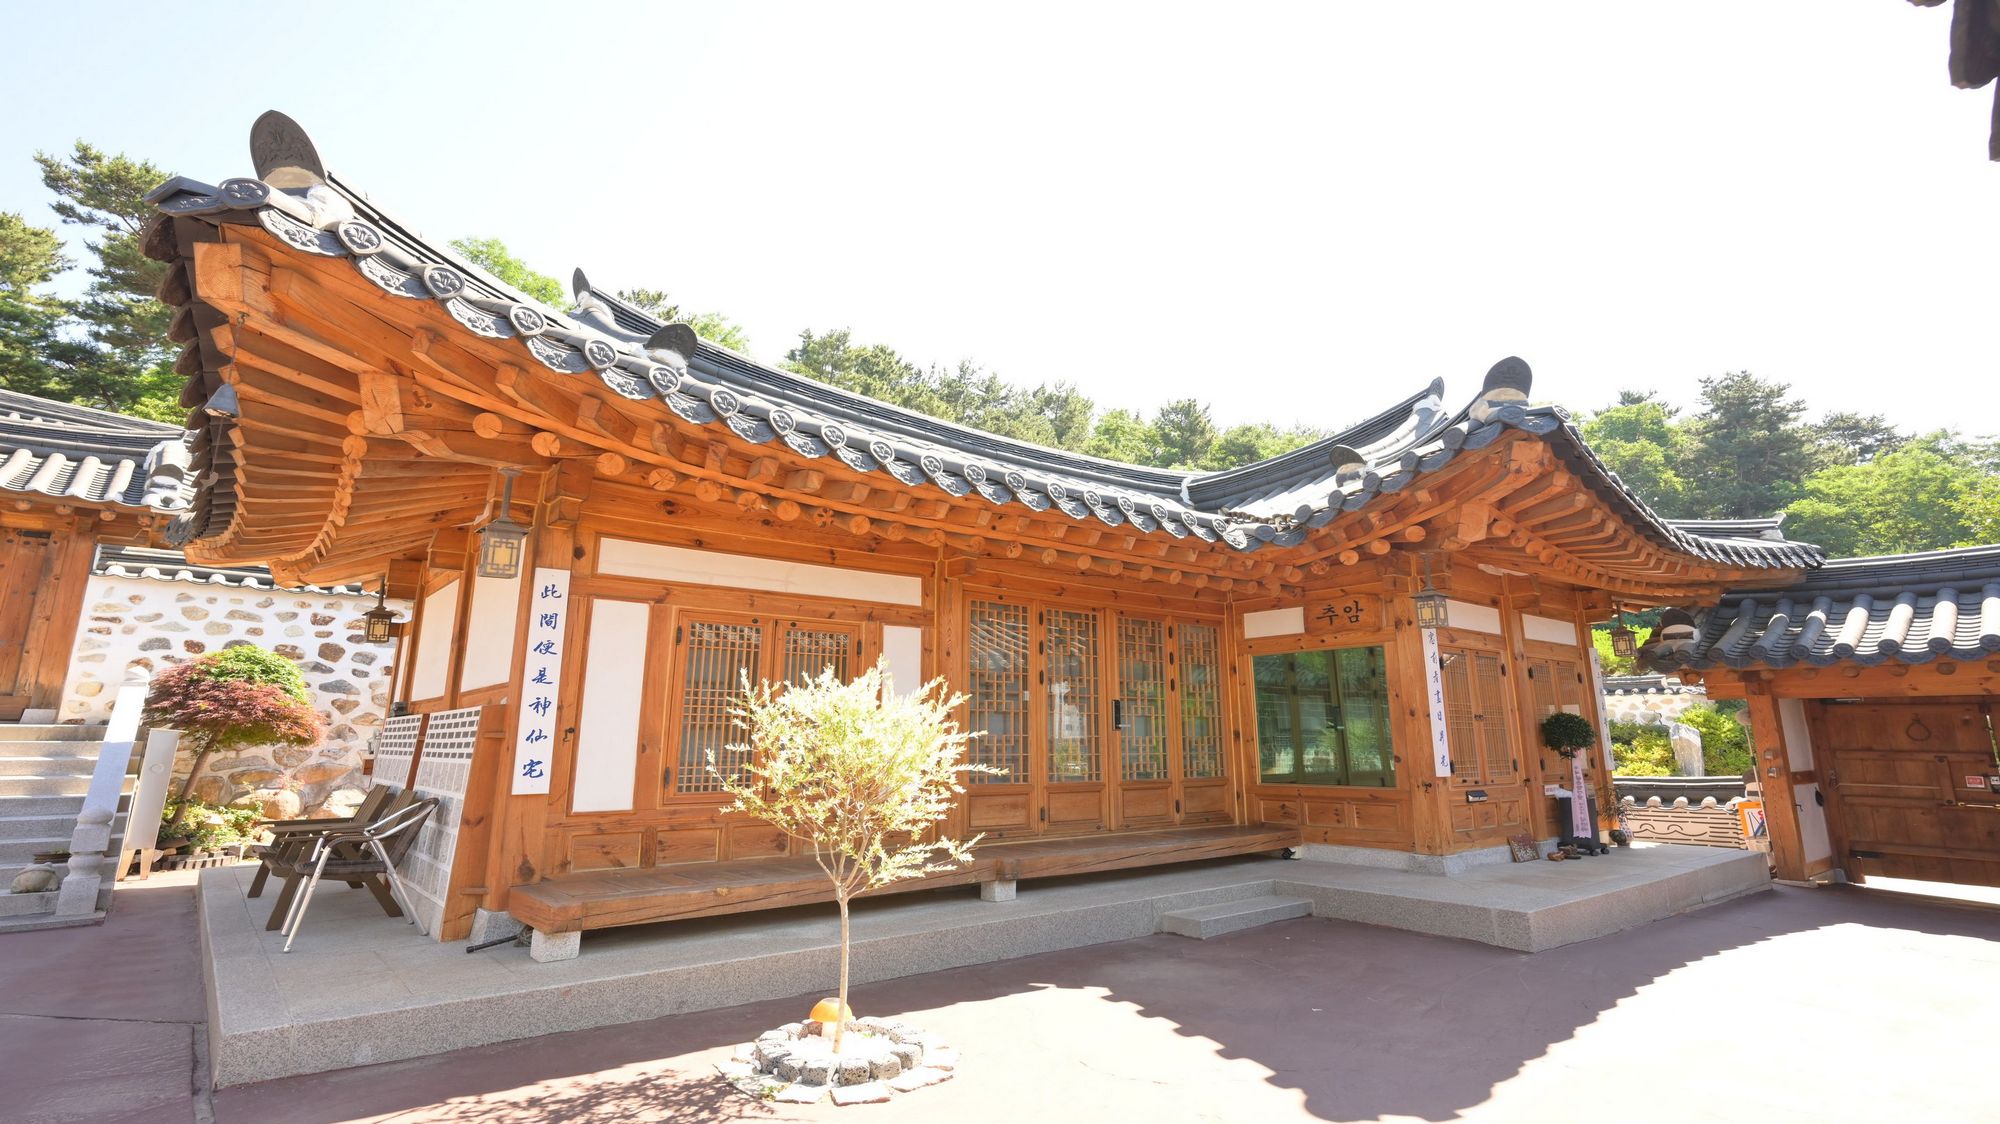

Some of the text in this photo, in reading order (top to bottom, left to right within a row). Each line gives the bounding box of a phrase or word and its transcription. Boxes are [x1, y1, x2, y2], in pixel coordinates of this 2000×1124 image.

[1316, 600, 1364, 625] 추암
[523, 584, 562, 778] 此間便是神仙宅
